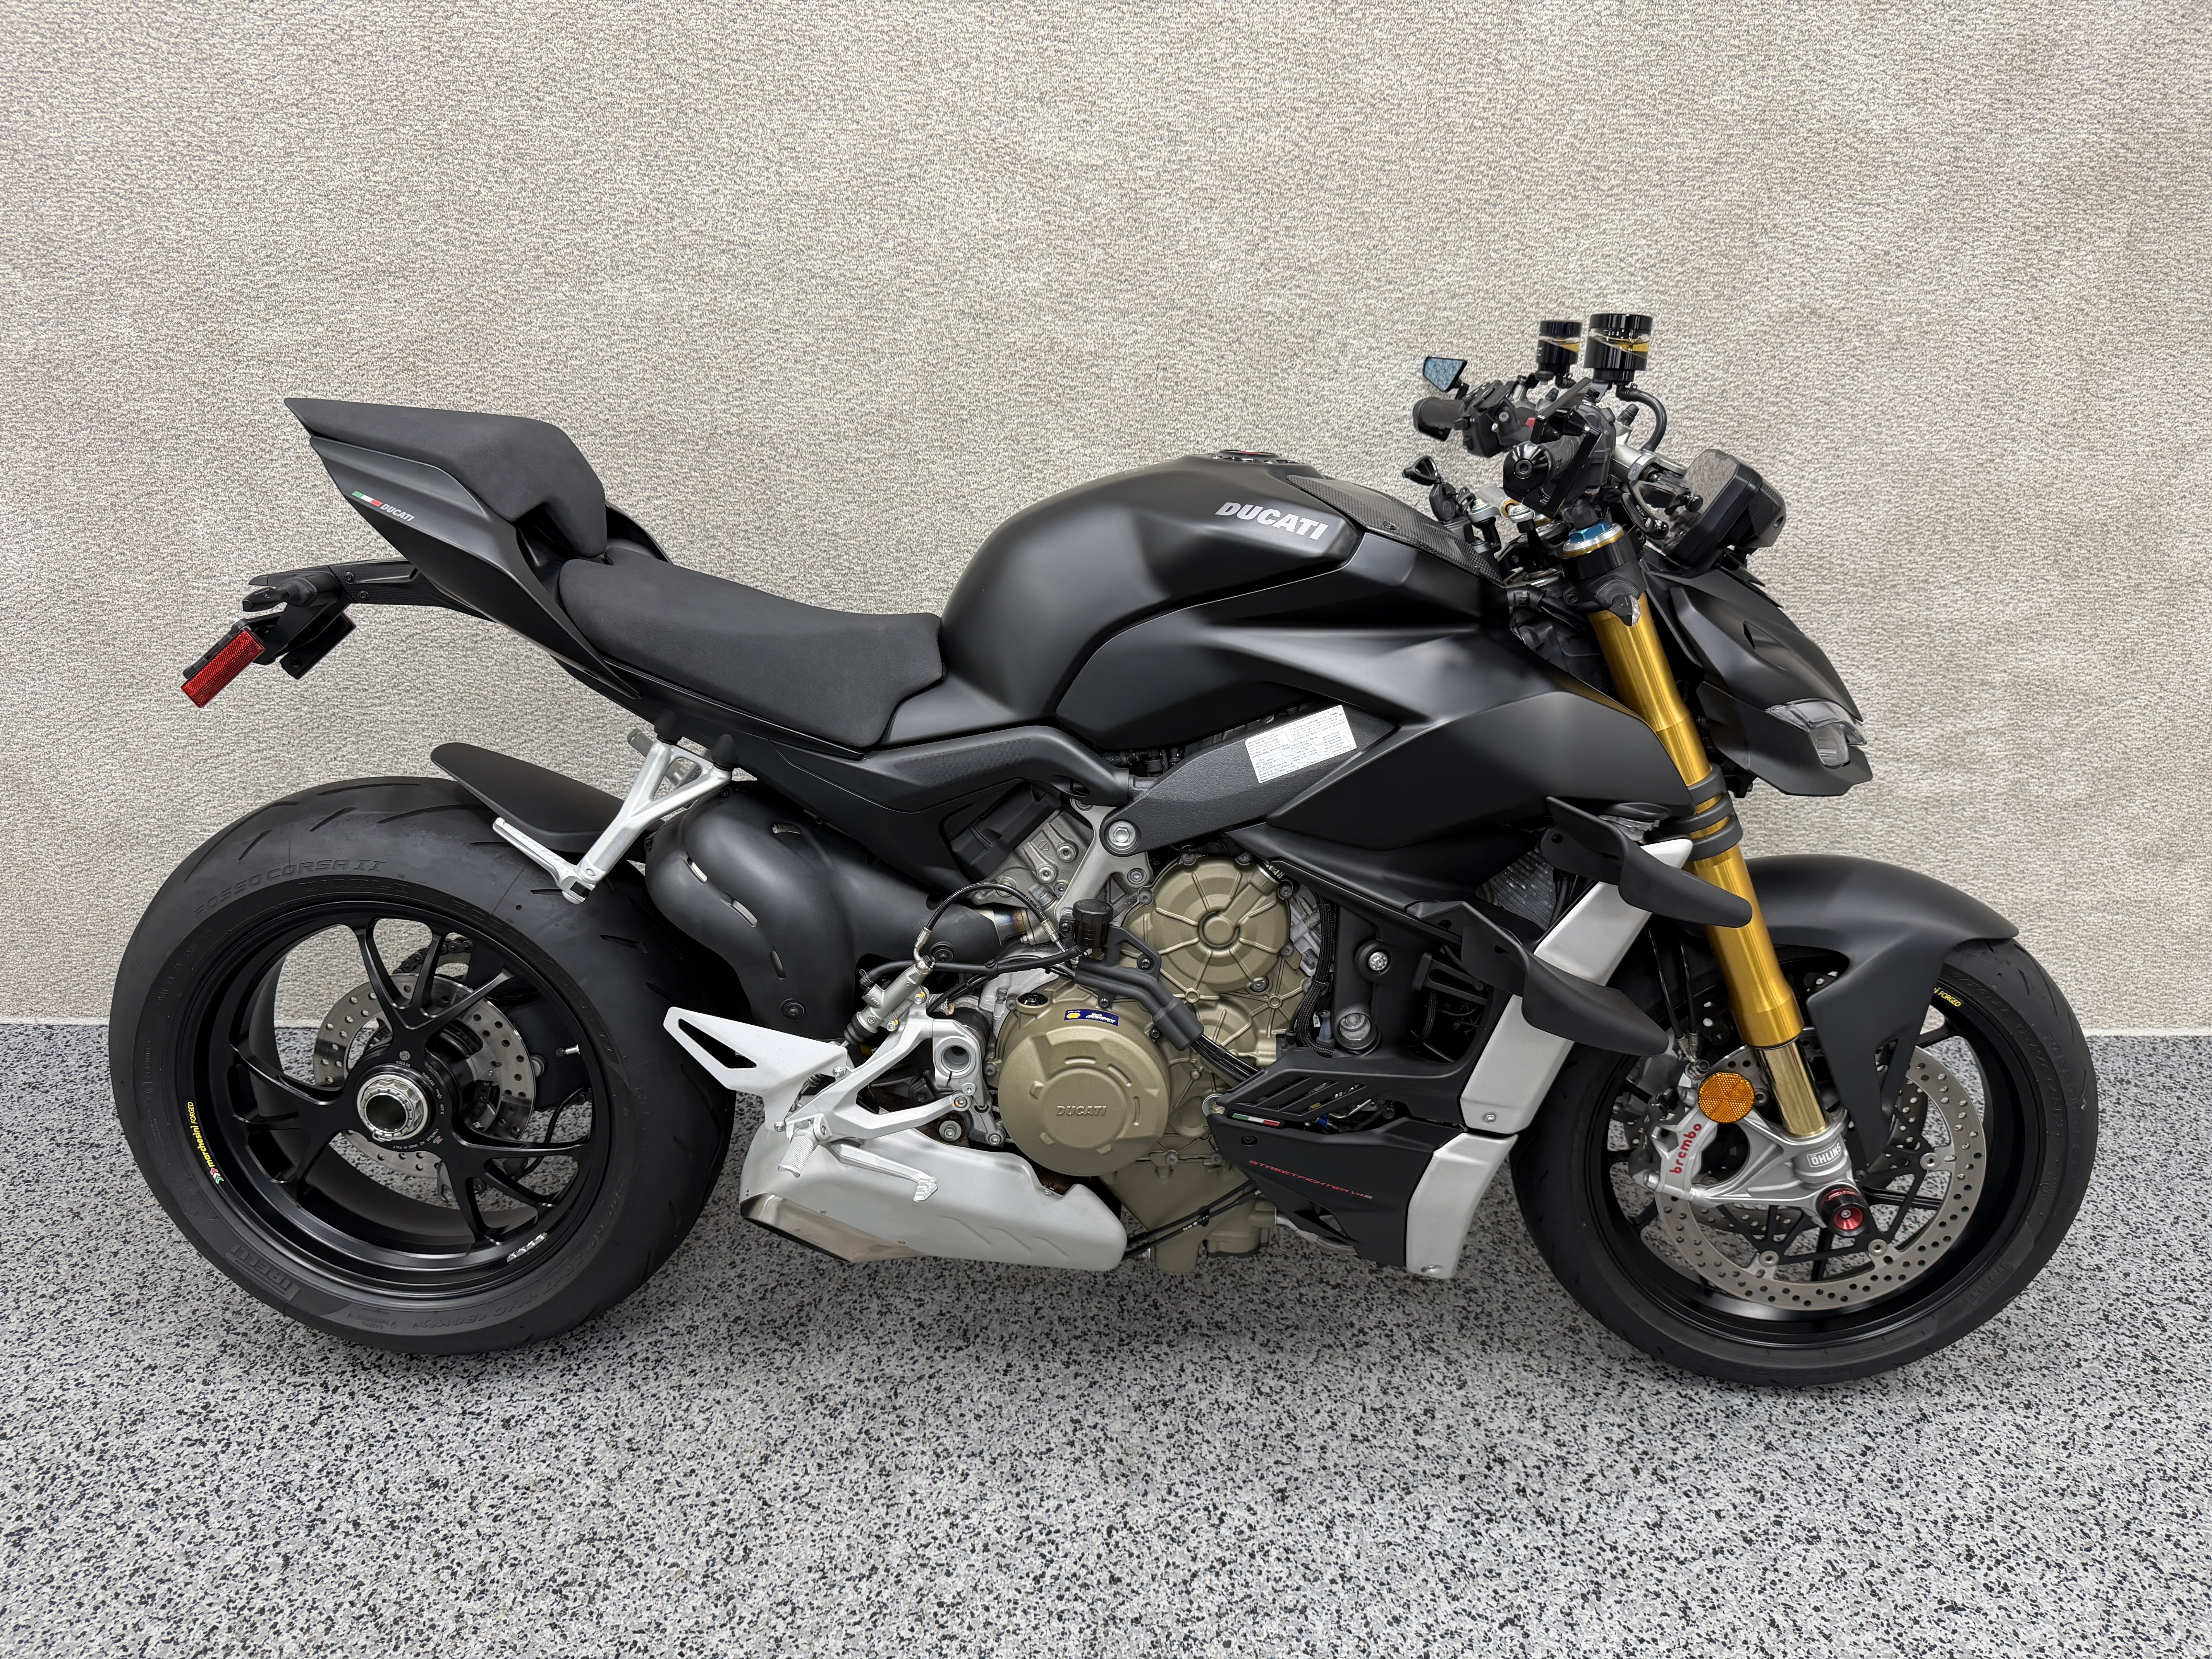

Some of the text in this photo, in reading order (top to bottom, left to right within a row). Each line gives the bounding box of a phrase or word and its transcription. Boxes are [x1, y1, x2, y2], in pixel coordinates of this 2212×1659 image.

[380, 503, 415, 522] DUCATI
[1215, 502, 1329, 540] DUCATI
[194, 874, 262, 914] ROSSO
[267, 859, 350, 881] CORSA
[1937, 991, 1962, 1007] FORGED
[1056, 1106, 1107, 1116] DUCATI
[187, 1101, 215, 1168] marchesini FORGED
[1669, 1123, 1702, 1174] brembo
[1810, 1142, 1842, 1166] ÖHLINS
[1249, 1160, 1349, 1193] STREETFIGHTER
[230, 1243, 302, 1303] PIRELLI
